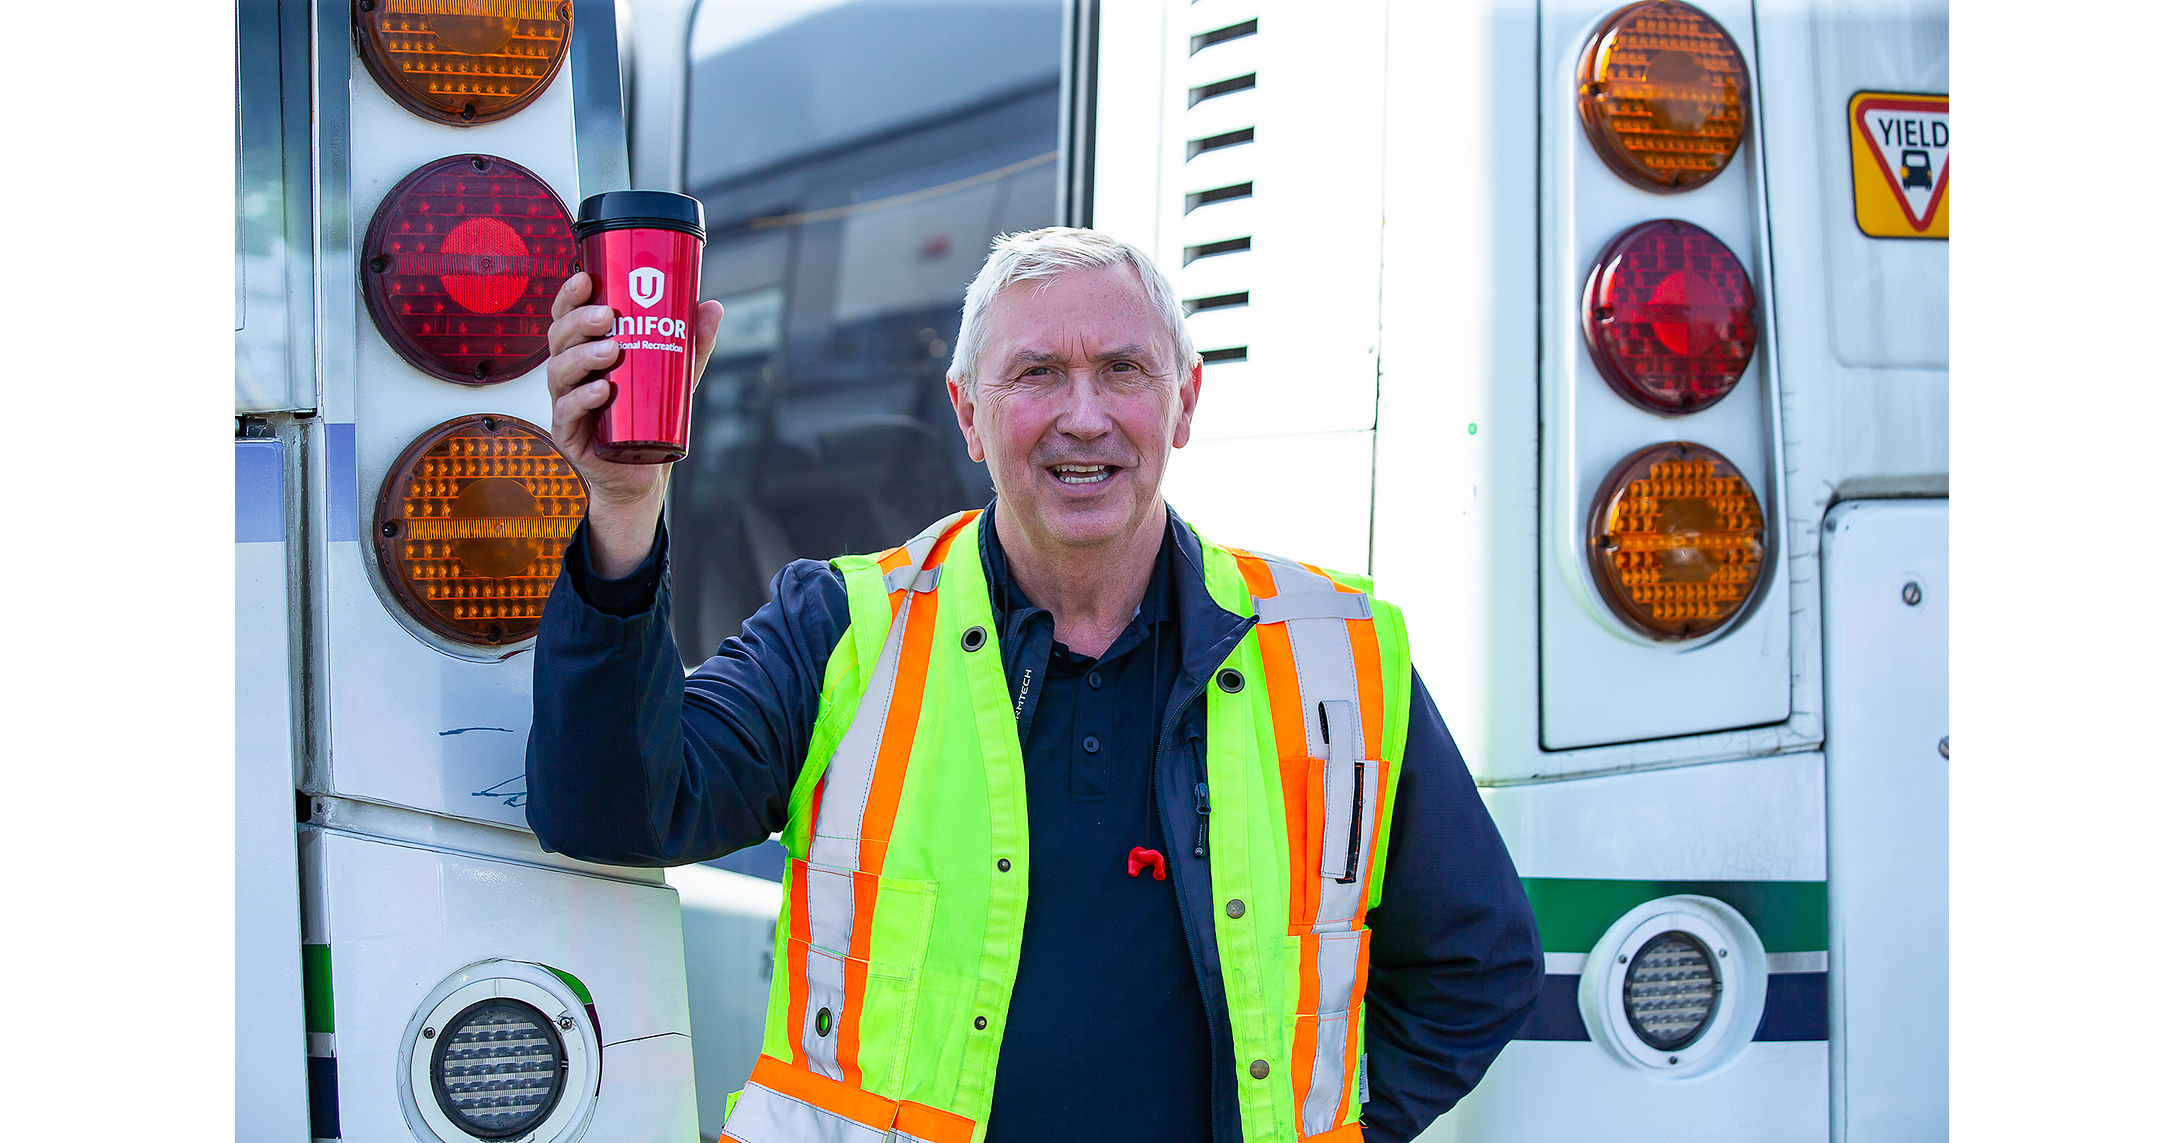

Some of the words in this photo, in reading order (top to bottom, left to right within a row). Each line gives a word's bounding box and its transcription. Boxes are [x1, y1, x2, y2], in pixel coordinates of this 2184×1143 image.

[1878, 118, 1949, 147] YIELD
[619, 340, 640, 350] ional
[642, 340, 683, 353] Recreation
[1015, 668, 1032, 723] RMTECH
